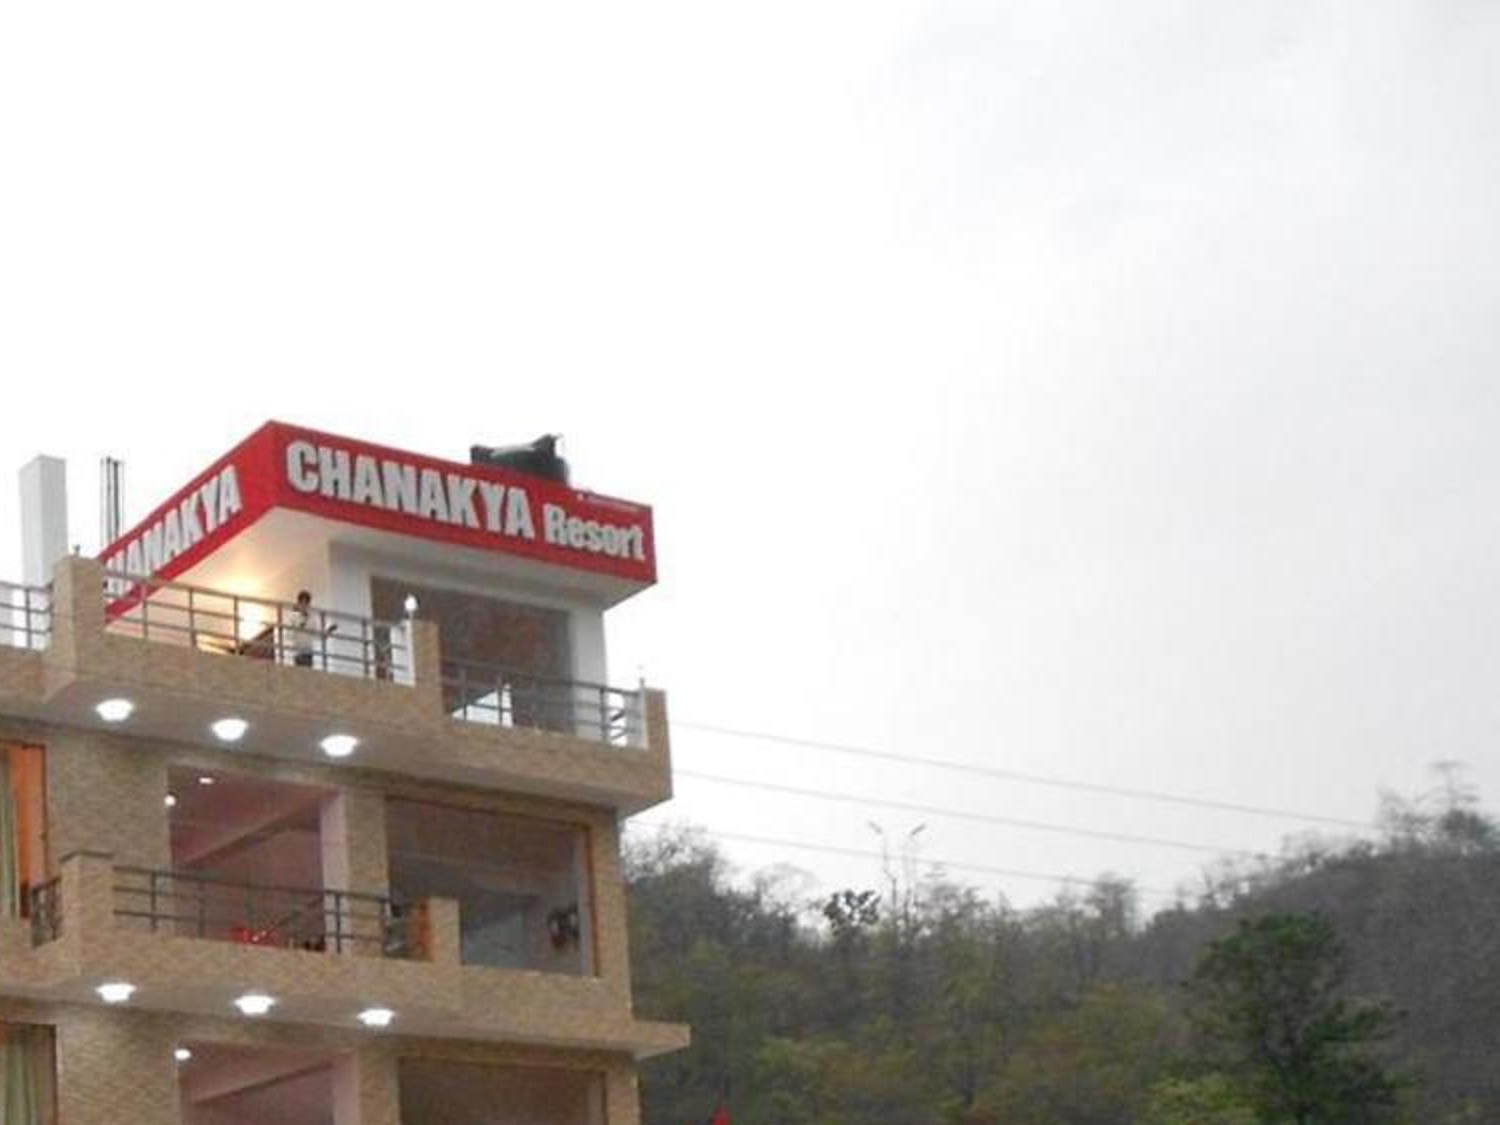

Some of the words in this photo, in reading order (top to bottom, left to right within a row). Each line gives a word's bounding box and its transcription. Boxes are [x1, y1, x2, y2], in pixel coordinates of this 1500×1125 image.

[104, 464, 243, 604] HANAKYA
[286, 440, 536, 541] CHANAKYA
[543, 503, 645, 561] Resort
